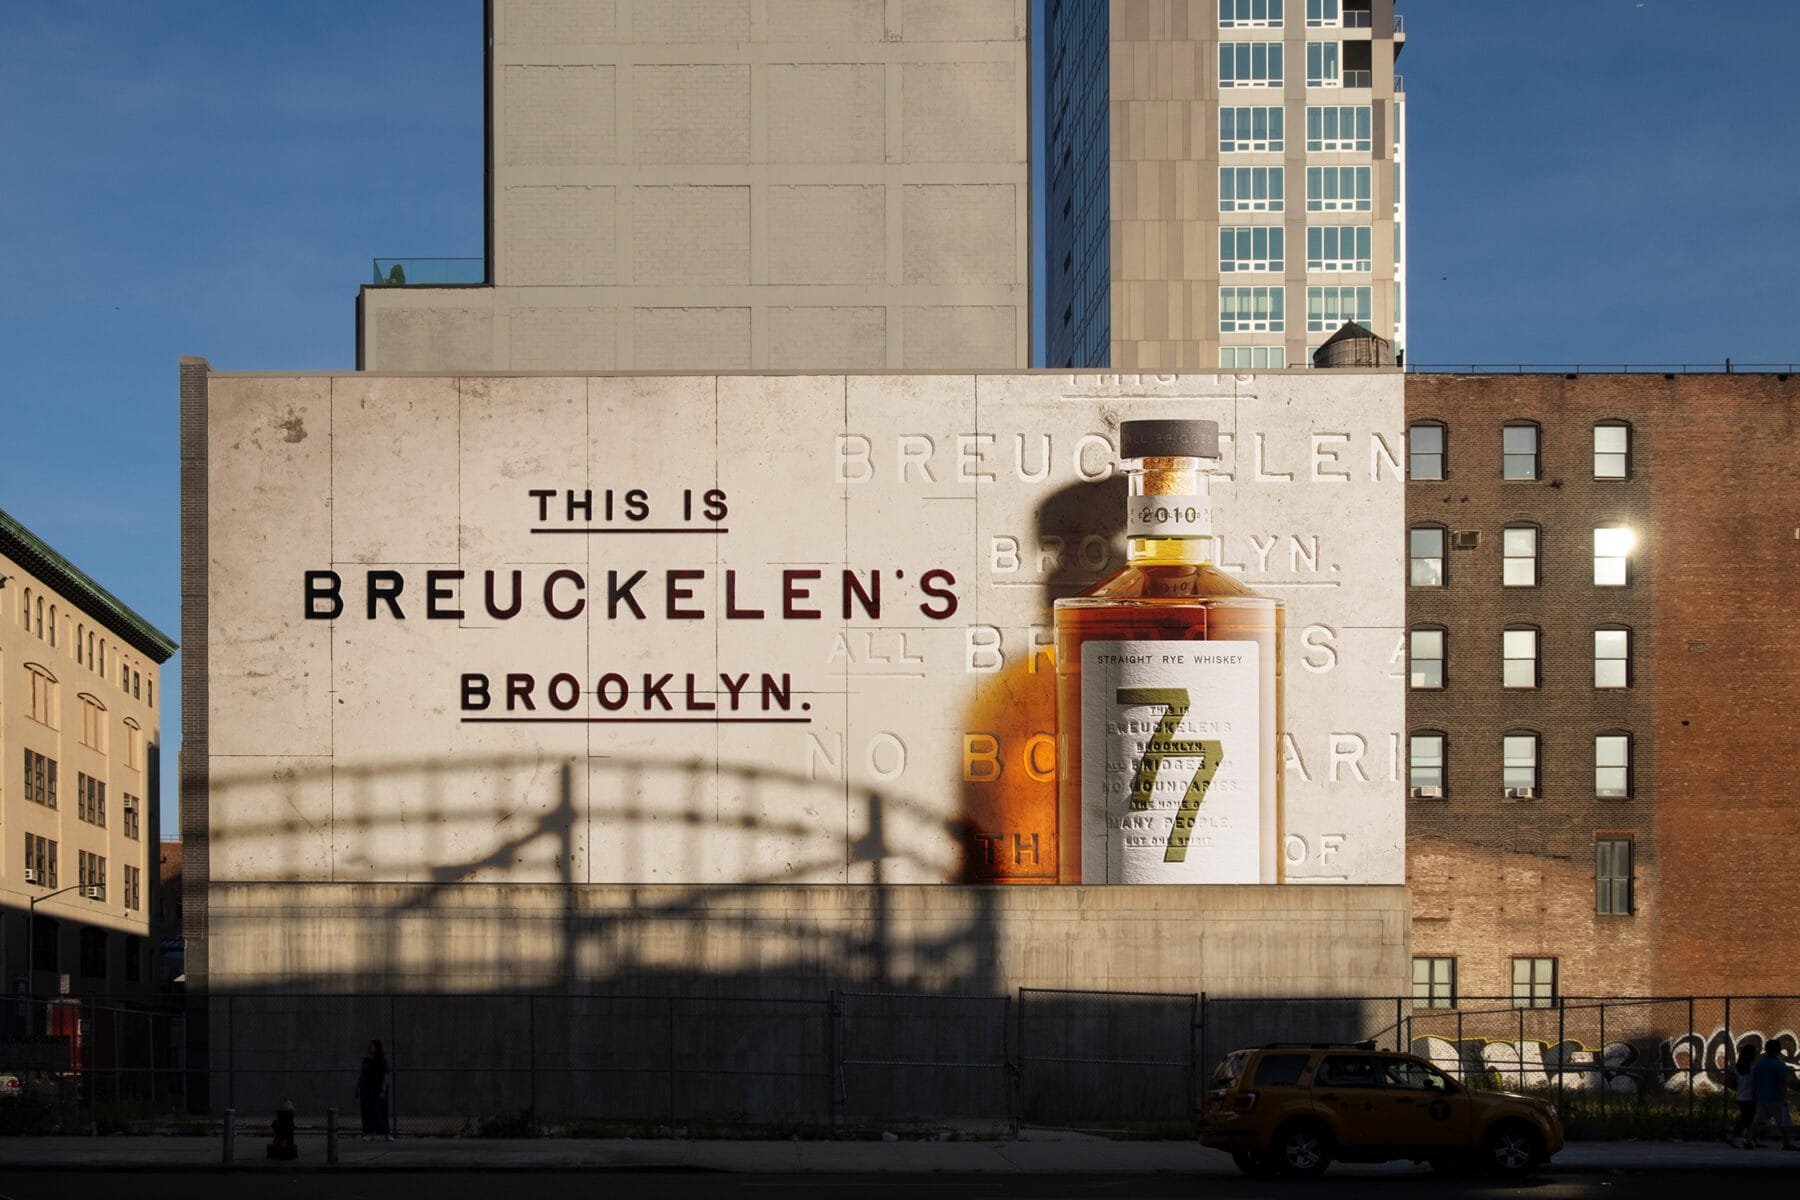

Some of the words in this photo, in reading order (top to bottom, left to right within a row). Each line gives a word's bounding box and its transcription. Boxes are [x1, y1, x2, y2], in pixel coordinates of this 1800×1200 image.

[836, 433, 1405, 483] BREUCELEN
[529, 489, 650, 521] THIS
[684, 489, 729, 521] IS
[1142, 507, 1197, 523] 2010
[991, 535, 1341, 573] BROLYN.
[304, 569, 959, 620] BREUCKELEN'S
[827, 631, 924, 664] ALL
[1097, 655, 1152, 665] STRAIGHT
[1162, 655, 1184, 665] RYE
[1194, 655, 1243, 665] WHISKEY
[461, 672, 812, 711] BROOKLYN.
[806, 731, 908, 783] NO
[963, 731, 1401, 783] BOARI
[1131, 759, 1205, 771] BRIDGES
[1109, 817, 1153, 830] MANY
[975, 833, 1057, 865] TH
[1285, 834, 1347, 866] OF
